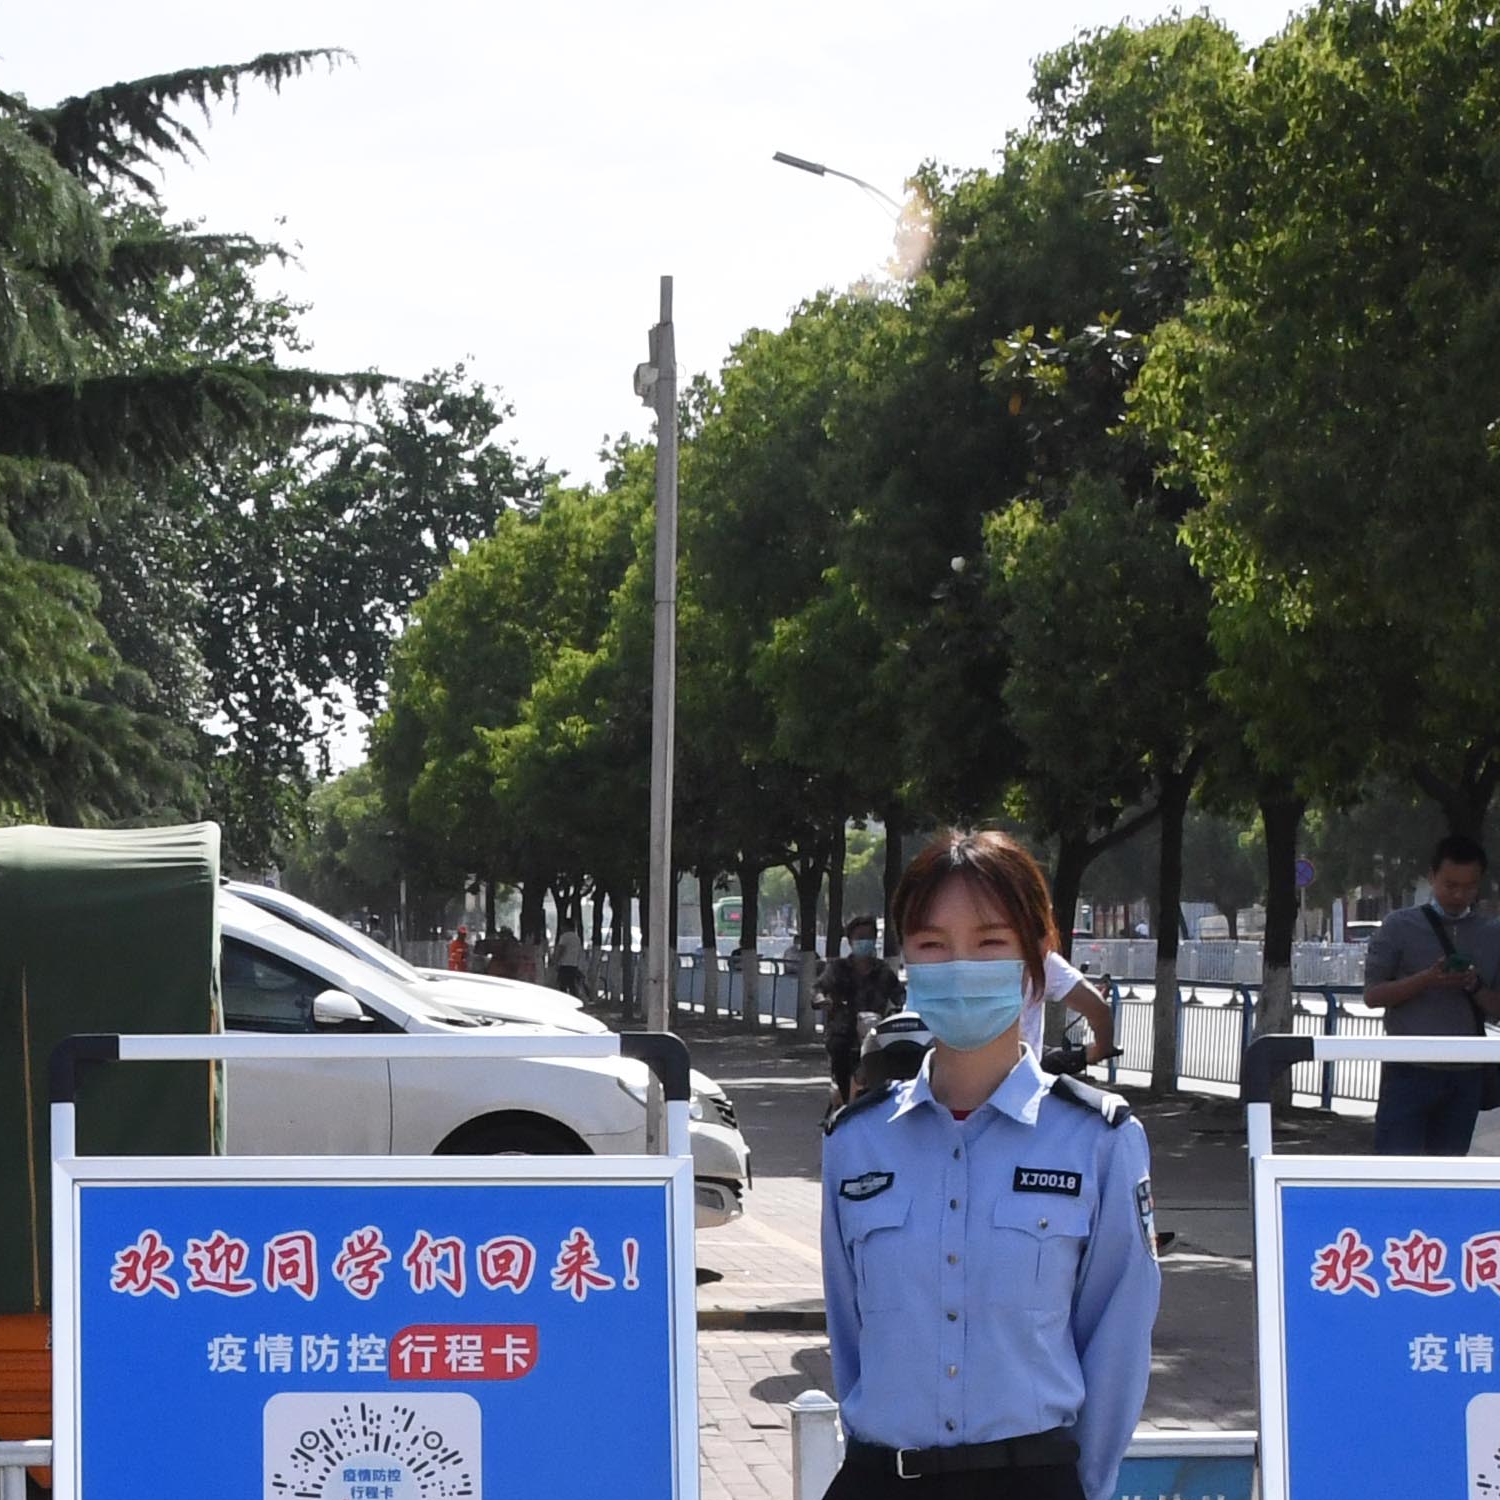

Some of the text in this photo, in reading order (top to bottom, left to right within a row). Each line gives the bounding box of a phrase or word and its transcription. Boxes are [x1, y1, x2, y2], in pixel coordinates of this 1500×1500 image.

[1019, 1172, 1077, 1190] XJ0018
[351, 1485, 394, 1500] 行程卡
